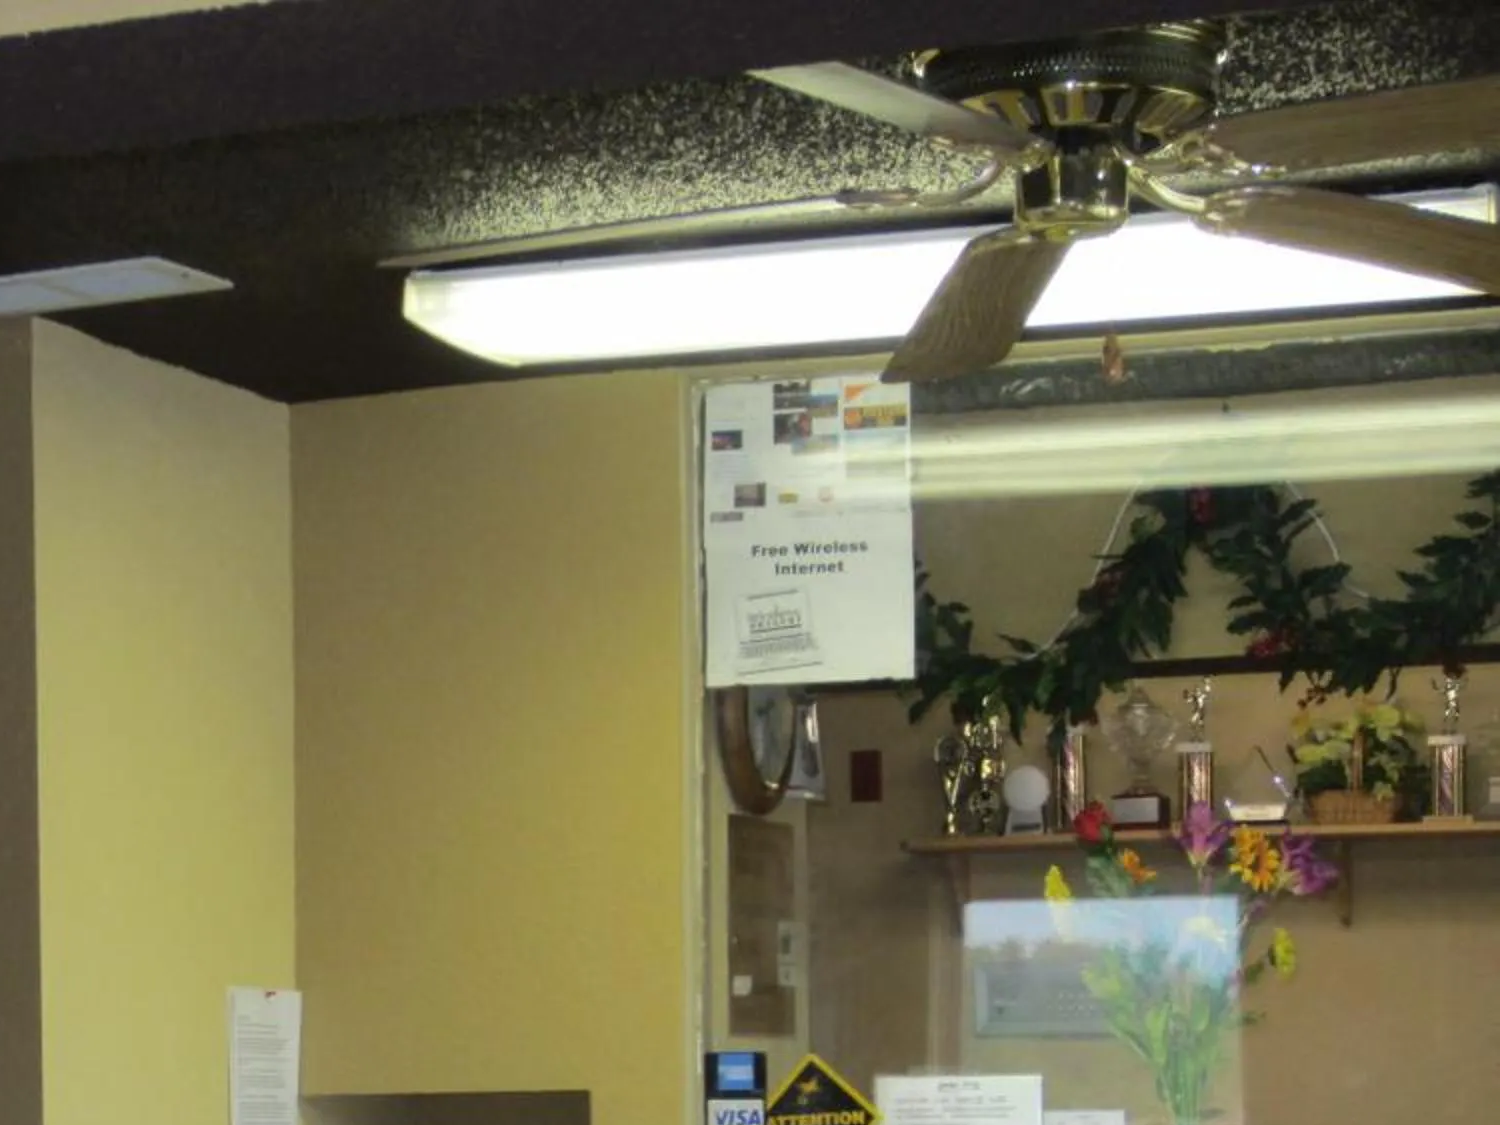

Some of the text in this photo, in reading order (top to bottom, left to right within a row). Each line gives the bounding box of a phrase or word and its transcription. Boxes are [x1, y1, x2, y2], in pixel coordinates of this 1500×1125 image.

[751, 540, 869, 558] Free Wireless
[774, 560, 844, 576] Internet
